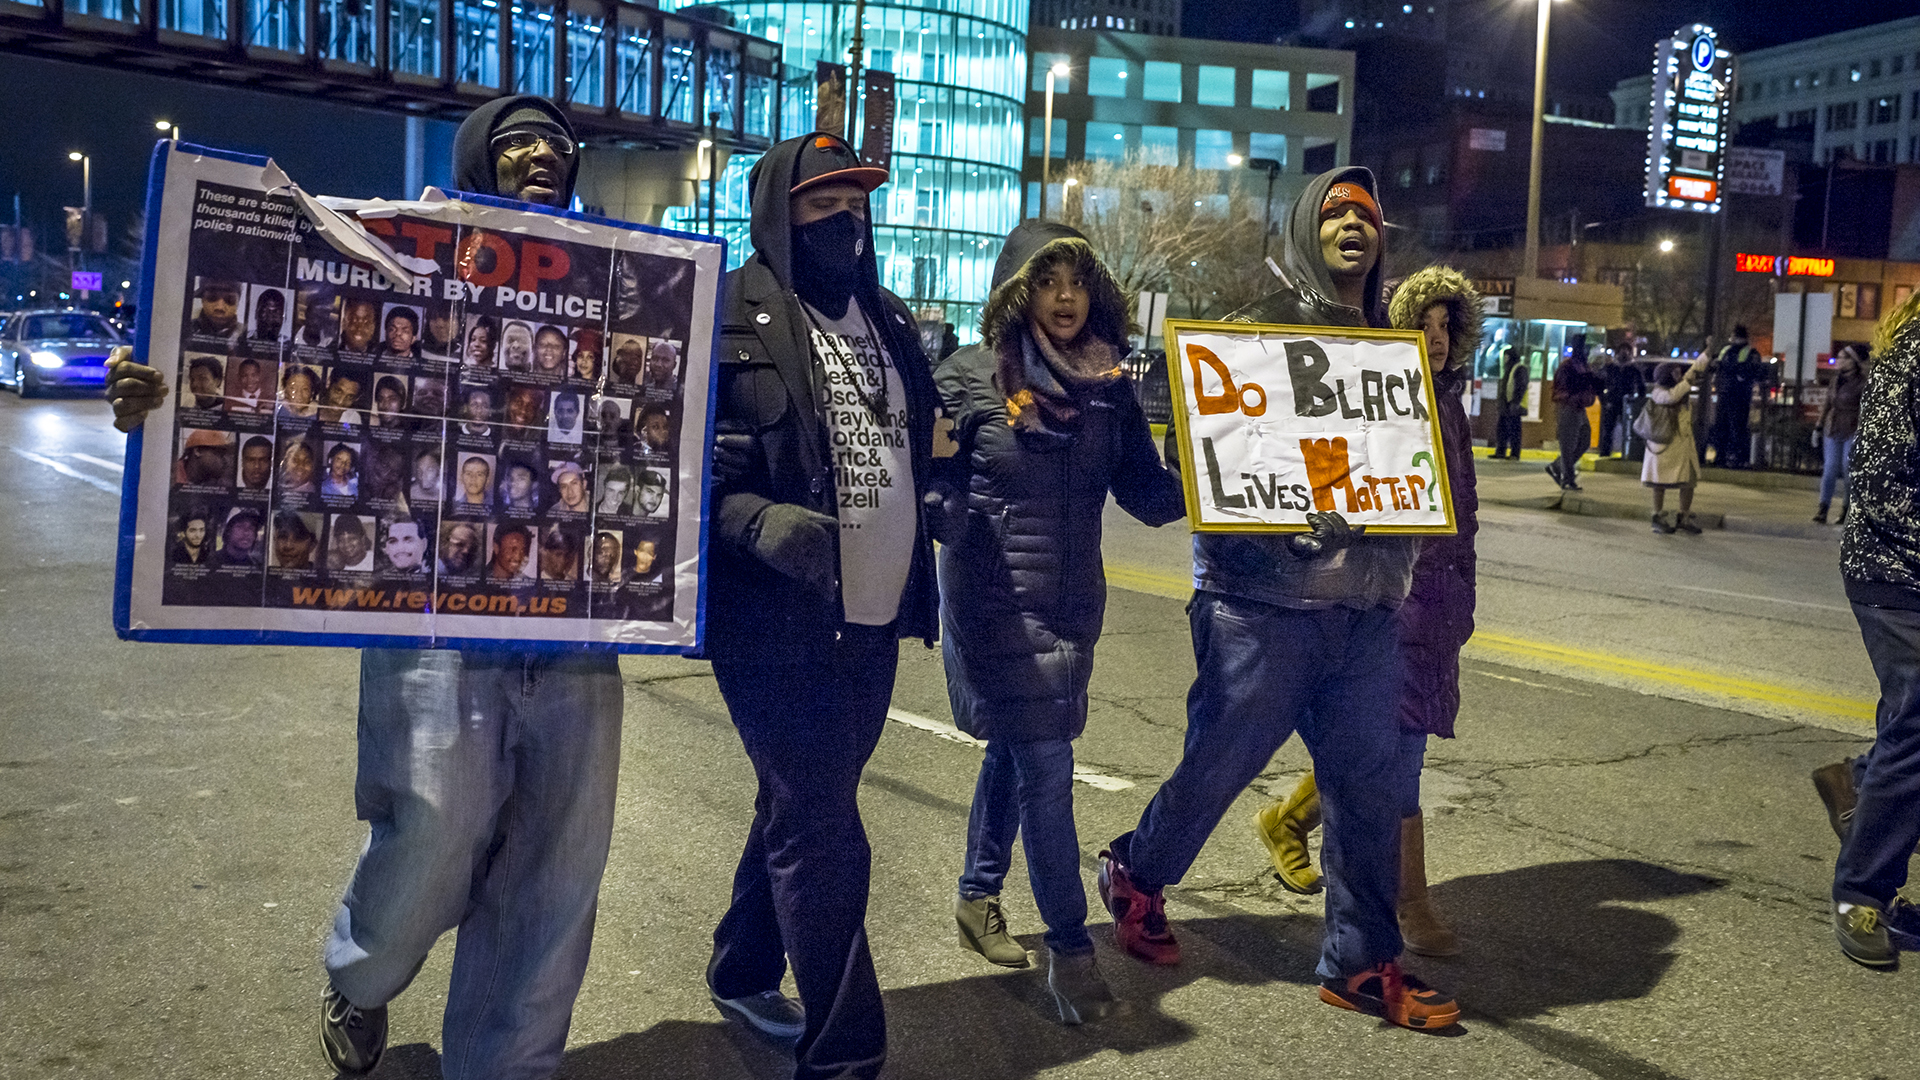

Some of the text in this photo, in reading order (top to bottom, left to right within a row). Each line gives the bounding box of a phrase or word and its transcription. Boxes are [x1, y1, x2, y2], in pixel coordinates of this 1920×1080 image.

[1698, 42, 1710, 64] P
[199, 188, 235, 204] These
[238, 196, 257, 208] are
[260, 201, 294, 214] some
[194, 218, 303, 244] police nationwide
[196, 203, 315, 233] thousands killed by
[296, 257, 603, 321] MURDR BY POLICE
[824, 368, 881, 387] ean&
[1186, 340, 1429, 422] Do BLACK
[832, 427, 906, 449] ordan&
[839, 488, 880, 508] zell
[292, 586, 567, 614] www.revcom.us
